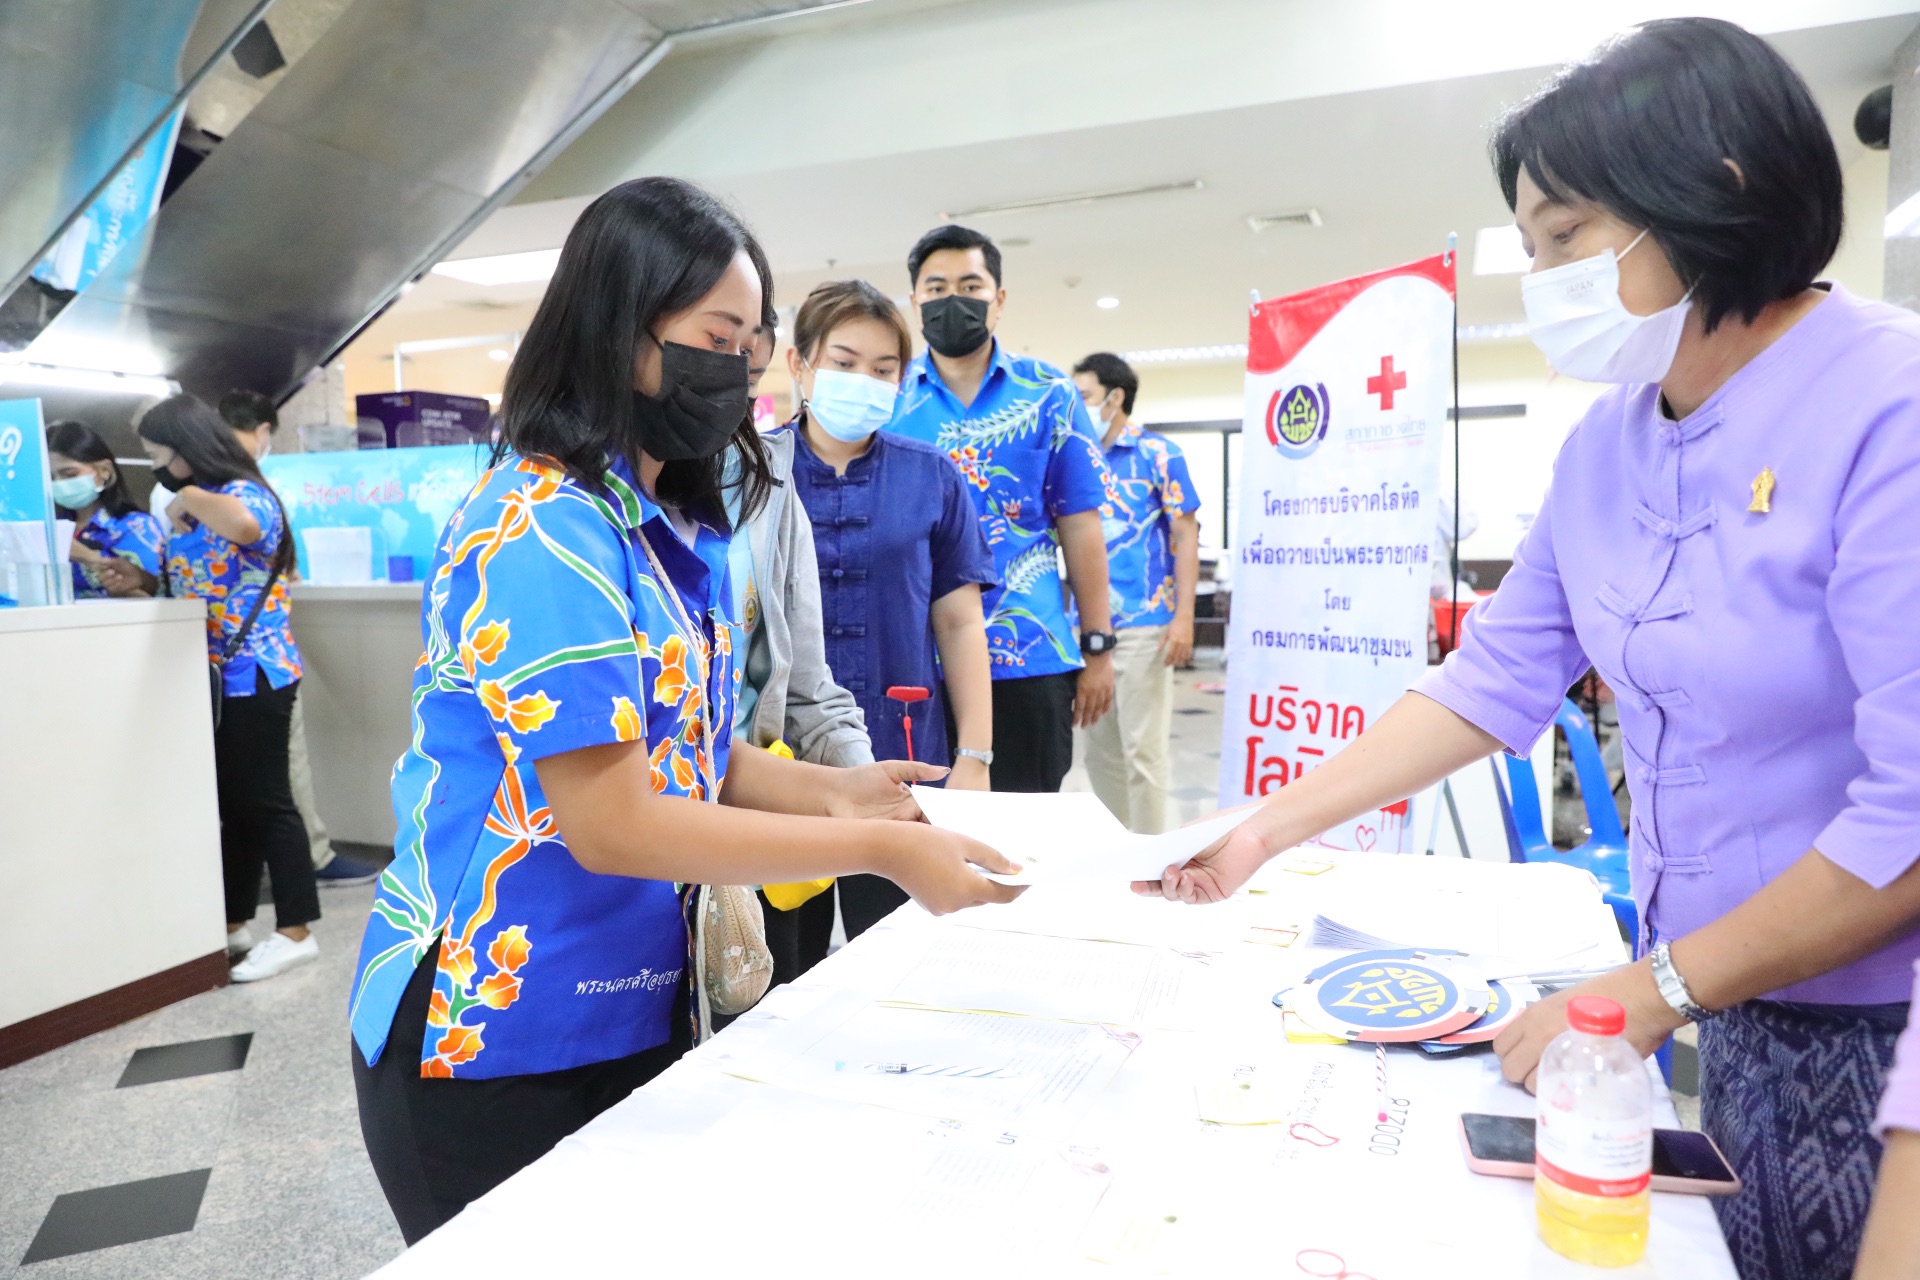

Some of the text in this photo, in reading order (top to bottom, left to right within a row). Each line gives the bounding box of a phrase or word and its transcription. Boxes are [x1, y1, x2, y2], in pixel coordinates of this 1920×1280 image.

[1566, 280, 1594, 296] JAPAN
[302, 481, 352, 507] Stem
[356, 479, 405, 504] Cells
[1263, 481, 1420, 516] โครงการบริจาคโลหิต
[1242, 532, 1429, 576] เพื่อถวายเป็นพระราชกุศล
[1324, 588, 1352, 611] โดย
[1252, 626, 1413, 667] กรมการพัฒนาชุมชน
[1249, 685, 1365, 740] บริจาค
